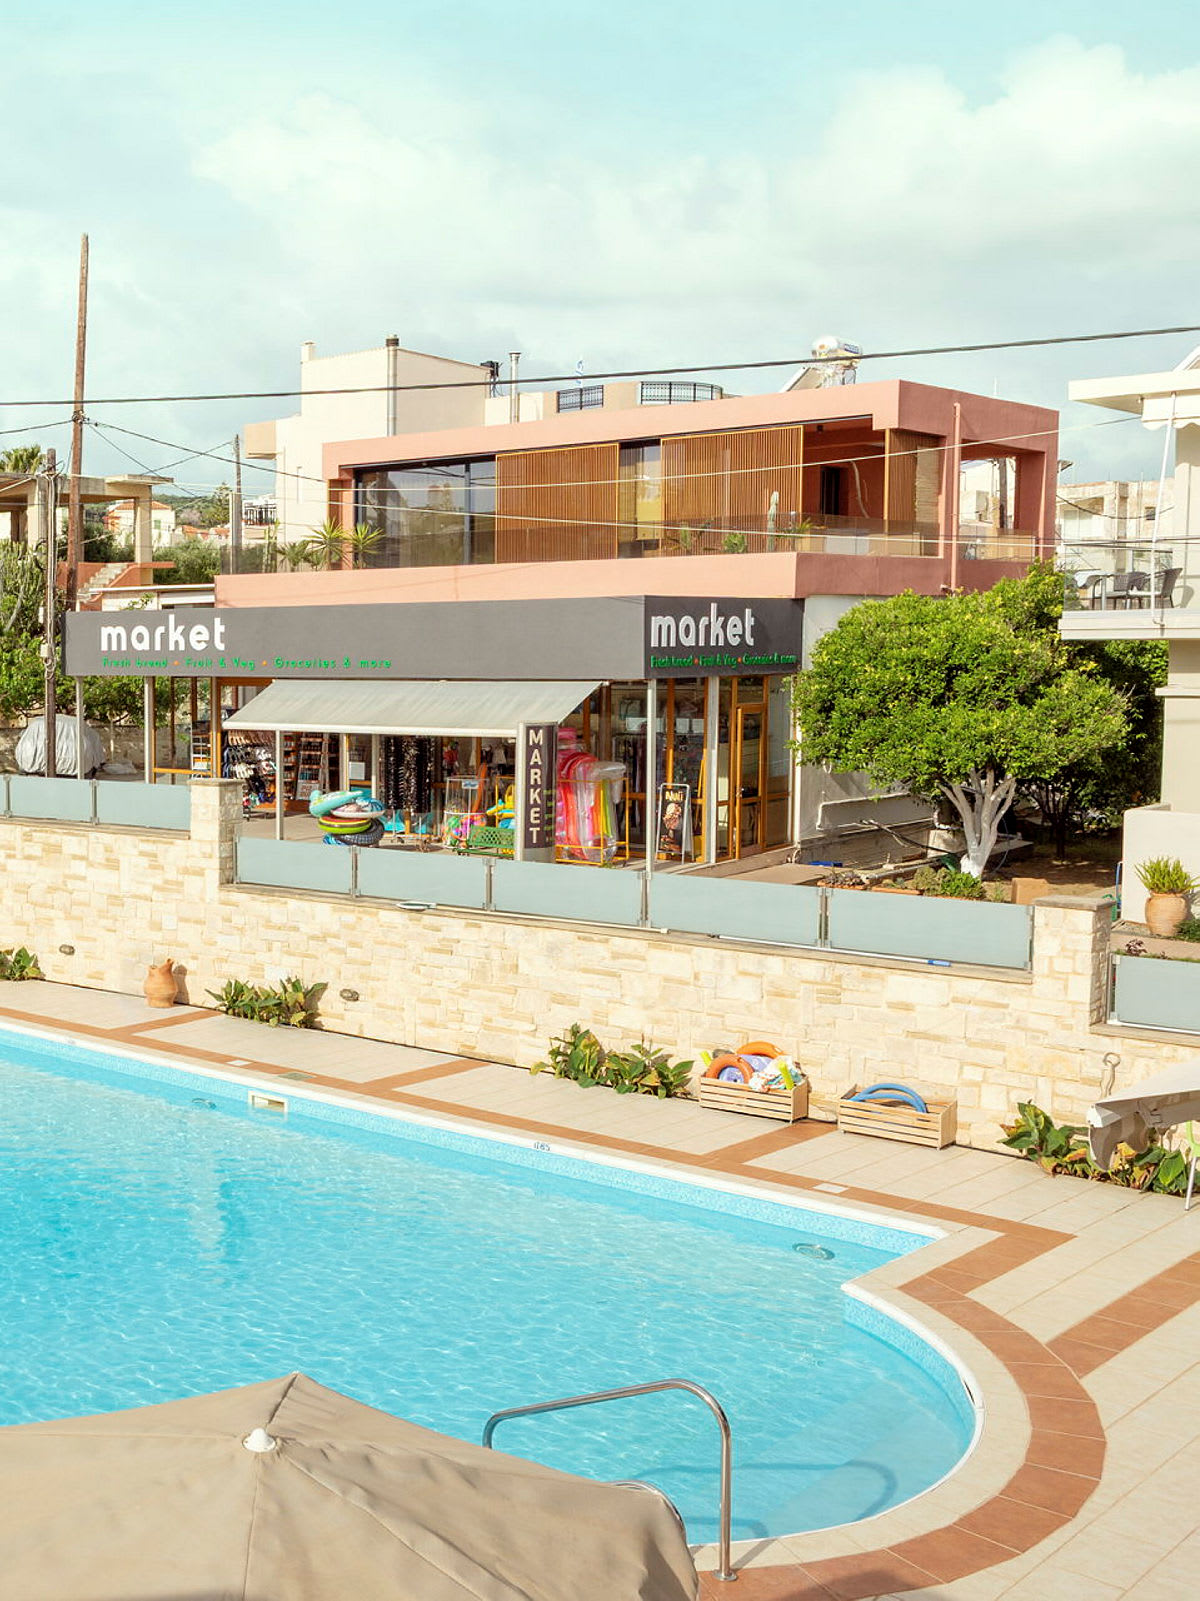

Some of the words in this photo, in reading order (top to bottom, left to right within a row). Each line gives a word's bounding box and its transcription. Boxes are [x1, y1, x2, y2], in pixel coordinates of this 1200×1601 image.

[100, 613, 226, 651] market
[650, 602, 755, 648] market
[232, 656, 256, 671] Veg
[273, 656, 337, 668] Groceries
[358, 659, 392, 668] more
[528, 729, 544, 844] MARKET
